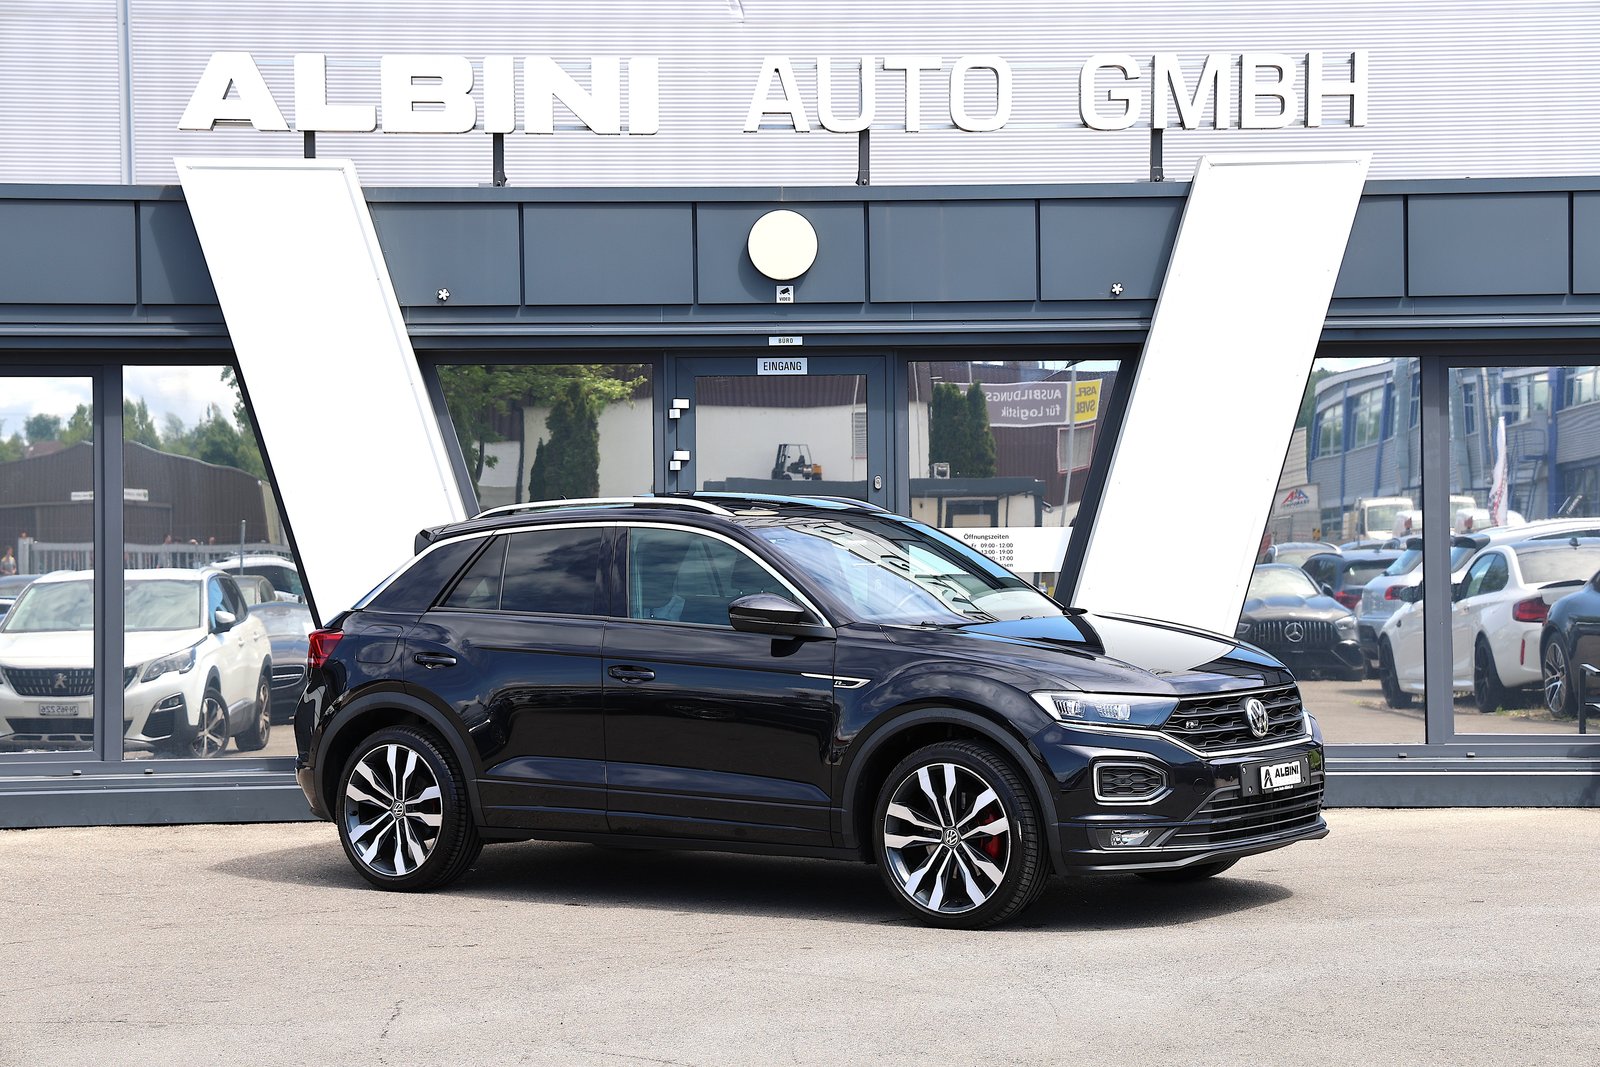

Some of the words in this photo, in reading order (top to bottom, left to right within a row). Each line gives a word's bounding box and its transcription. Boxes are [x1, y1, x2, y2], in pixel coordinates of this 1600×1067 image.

[177, 52, 659, 136] ALBINI
[743, 55, 1014, 134] AUTO
[1080, 50, 1370, 131] GMBH
[763, 361, 802, 371] EINGANG
[1275, 765, 1299, 778] ALBINI
